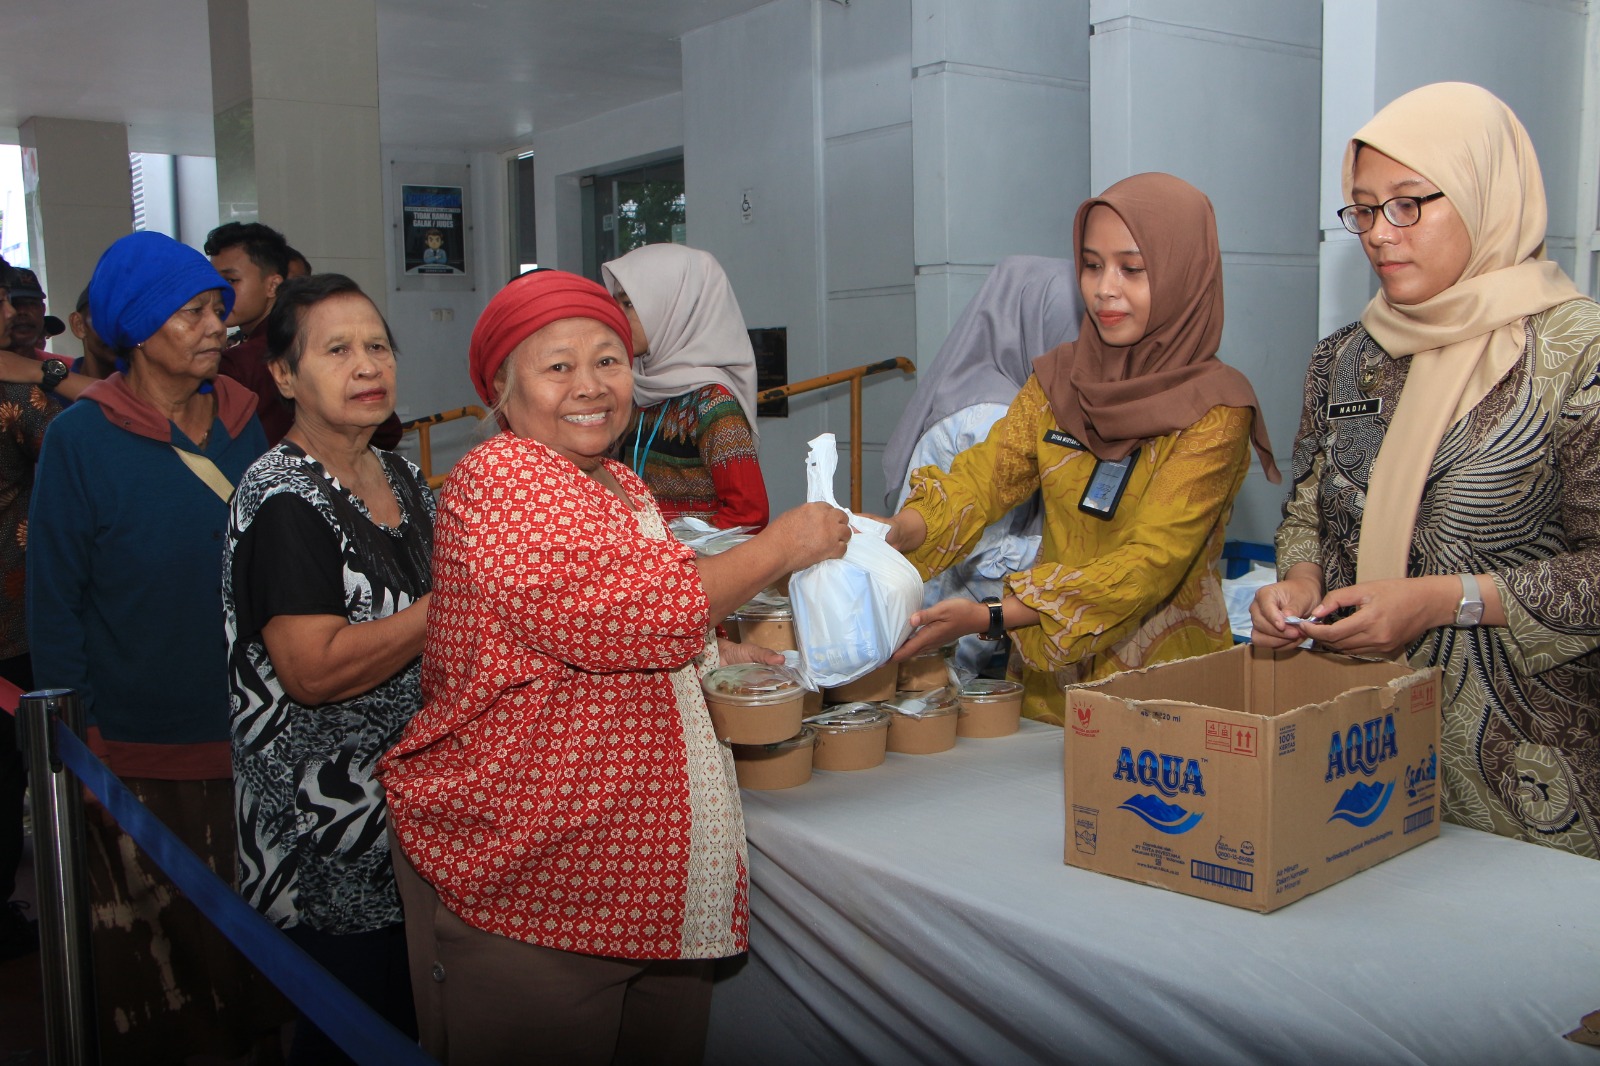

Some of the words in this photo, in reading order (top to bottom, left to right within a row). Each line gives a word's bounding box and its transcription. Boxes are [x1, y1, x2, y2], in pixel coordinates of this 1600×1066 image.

[413, 212, 432, 220] TIDAK
[413, 219, 432, 228] GALAK
[436, 220, 454, 228] JUDES
[1339, 404, 1367, 414] NADIA
[1172, 714, 1181, 722] ml
[1279, 732, 1296, 744] 100%
[1324, 713, 1398, 783] AQUA
[1113, 746, 1206, 798] AQUA
